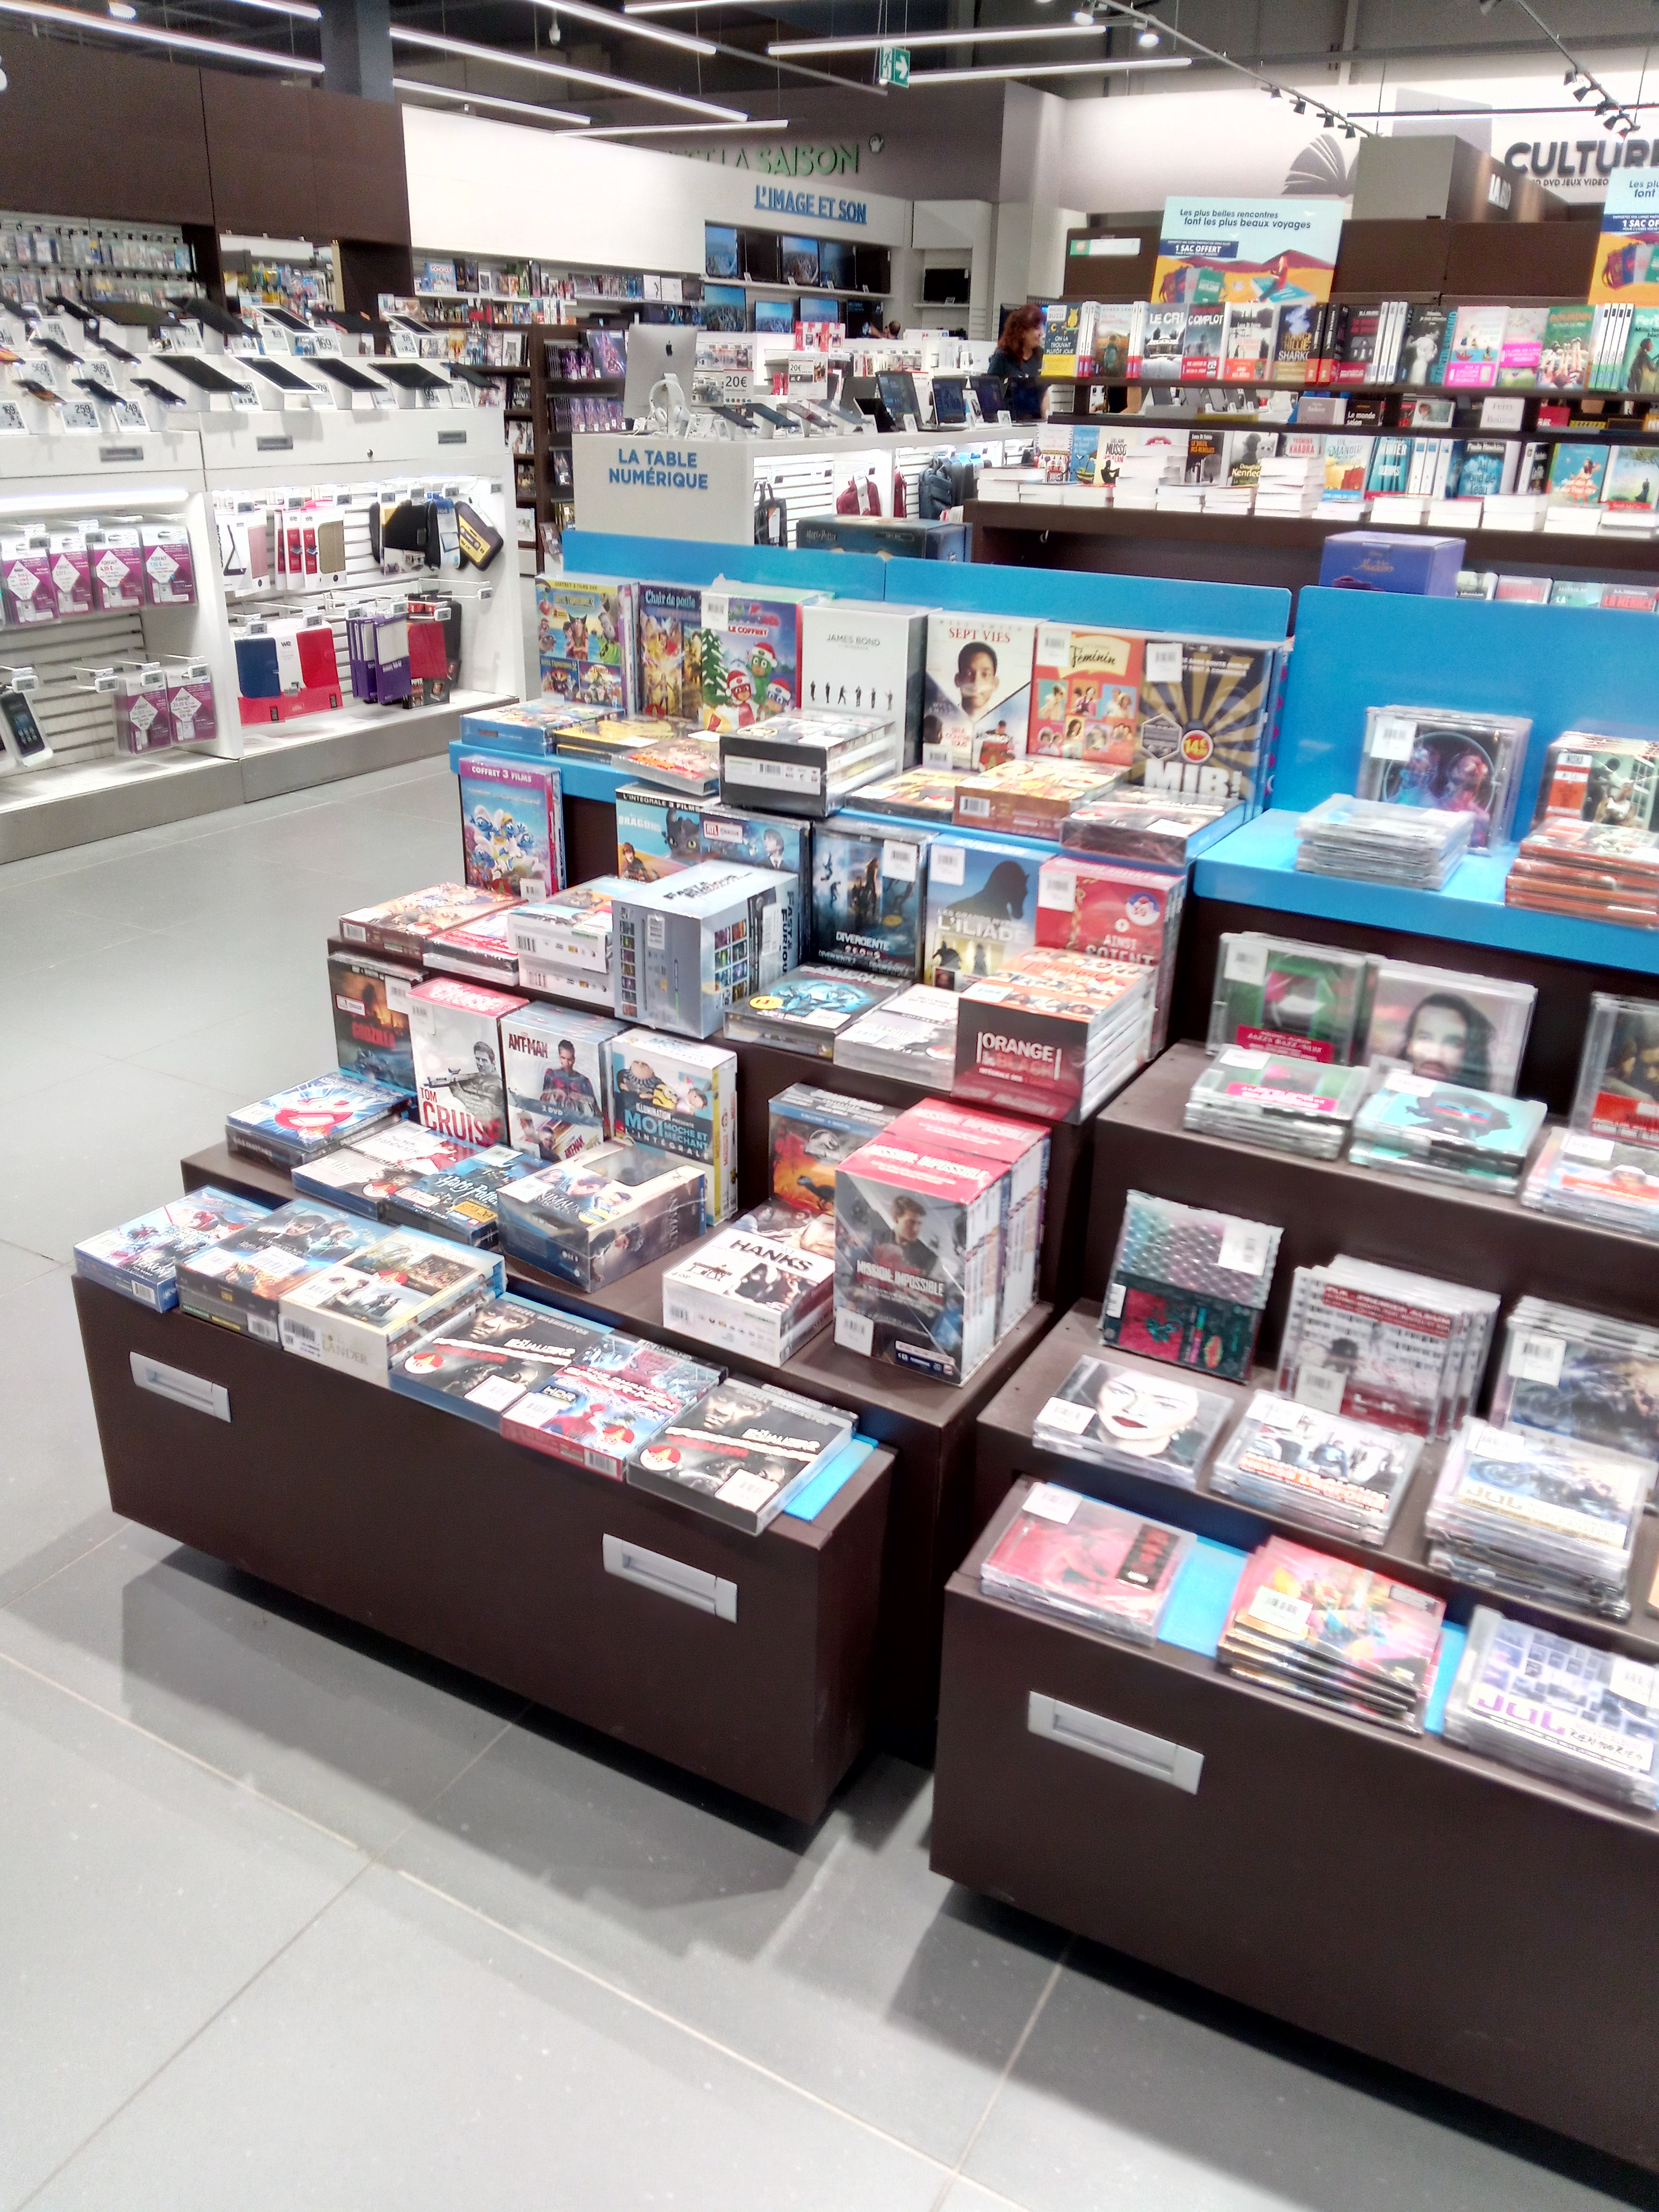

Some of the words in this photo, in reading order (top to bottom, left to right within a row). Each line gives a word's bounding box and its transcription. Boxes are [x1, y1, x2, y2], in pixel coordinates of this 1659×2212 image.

[758, 144, 859, 176] SAISON
[1629, 180, 1640, 188] Les
[755, 184, 815, 216] L'IMAGE
[819, 195, 836, 219] ET
[838, 199, 867, 224] SON
[1180, 208, 1192, 216] Les
[1194, 209, 1210, 218] plus
[1213, 210, 1235, 218] belles
[1184, 216, 1202, 225] font
[1204, 217, 1216, 226] les
[1218, 217, 1238, 228] plus
[1240, 218, 1269, 227] beaux
[1273, 221, 1311, 231] voyages
[1629, 219, 1647, 227] SAC
[1180, 244, 1195, 253] SAC
[1195, 245, 1222, 254] OFFERT
[430, 265, 453, 274] MONOPOLY
[1150, 312, 1162, 324] LE
[1188, 314, 1224, 325] COMPLOT
[92, 364, 106, 373] 369
[725, 376, 747, 388] 20€
[75, 404, 91, 414] 259
[1105, 443, 1127, 456] MUSSO
[1289, 444, 1315, 454] KHADRA
[1329, 446, 1362, 456] MANOIR
[618, 447, 640, 465] LA
[644, 449, 697, 468] TABLE
[608, 467, 708, 490] NUMÉRIQUE
[644, 589, 665, 606] Chair
[665, 593, 675, 607] de
[675, 594, 696, 608] poule
[1556, 595, 1566, 604] LA
[735, 626, 768, 636] COFFRET
[949, 627, 977, 640] SEPT
[982, 629, 1010, 643] VIES
[827, 633, 854, 644] JAMES
[855, 635, 881, 647] BOND
[471, 766, 500, 778] COFFRET
[502, 769, 509, 779] 3
[510, 773, 532, 783] FILMS
[1144, 758, 1230, 798] MIB
[676, 803, 700, 813] FILMS
[705, 824, 719, 836] RTL
[937, 914, 1030, 944] L'ILIADE
[836, 931, 891, 952] DIVERGENTE
[1103, 934, 1138, 949] AINSI
[508, 1033, 548, 1059] ANT-MAN
[982, 1033, 1056, 1063] ORANGE
[419, 1087, 437, 1103] TOM
[547, 1107, 563, 1116] DVD
[422, 1101, 502, 1148] CRUISE
[624, 1109, 664, 1137] MOI
[663, 1121, 696, 1137] MOCHE
[698, 1131, 709, 1142] ET
[917, 1156, 992, 1181] IMPOSSIBLE
[433, 1174, 474, 1197] Harry
[473, 1184, 499, 1206] Potter
[729, 1239, 814, 1272] HANKS
[770, 1243, 795, 1256] TOM
[130, 1256, 169, 1278] VENOM
[894, 1270, 945, 1297] IMPOSSIBLE
[505, 1302, 536, 1319] DENZEL
[535, 1313, 590, 1337] WASHINGTON
[542, 1385, 578, 1403] HDR
[771, 1400, 831, 1427] WASHINGTON
[1465, 1485, 1524, 1510] JUL
[1476, 1695, 1566, 1736] JUL
